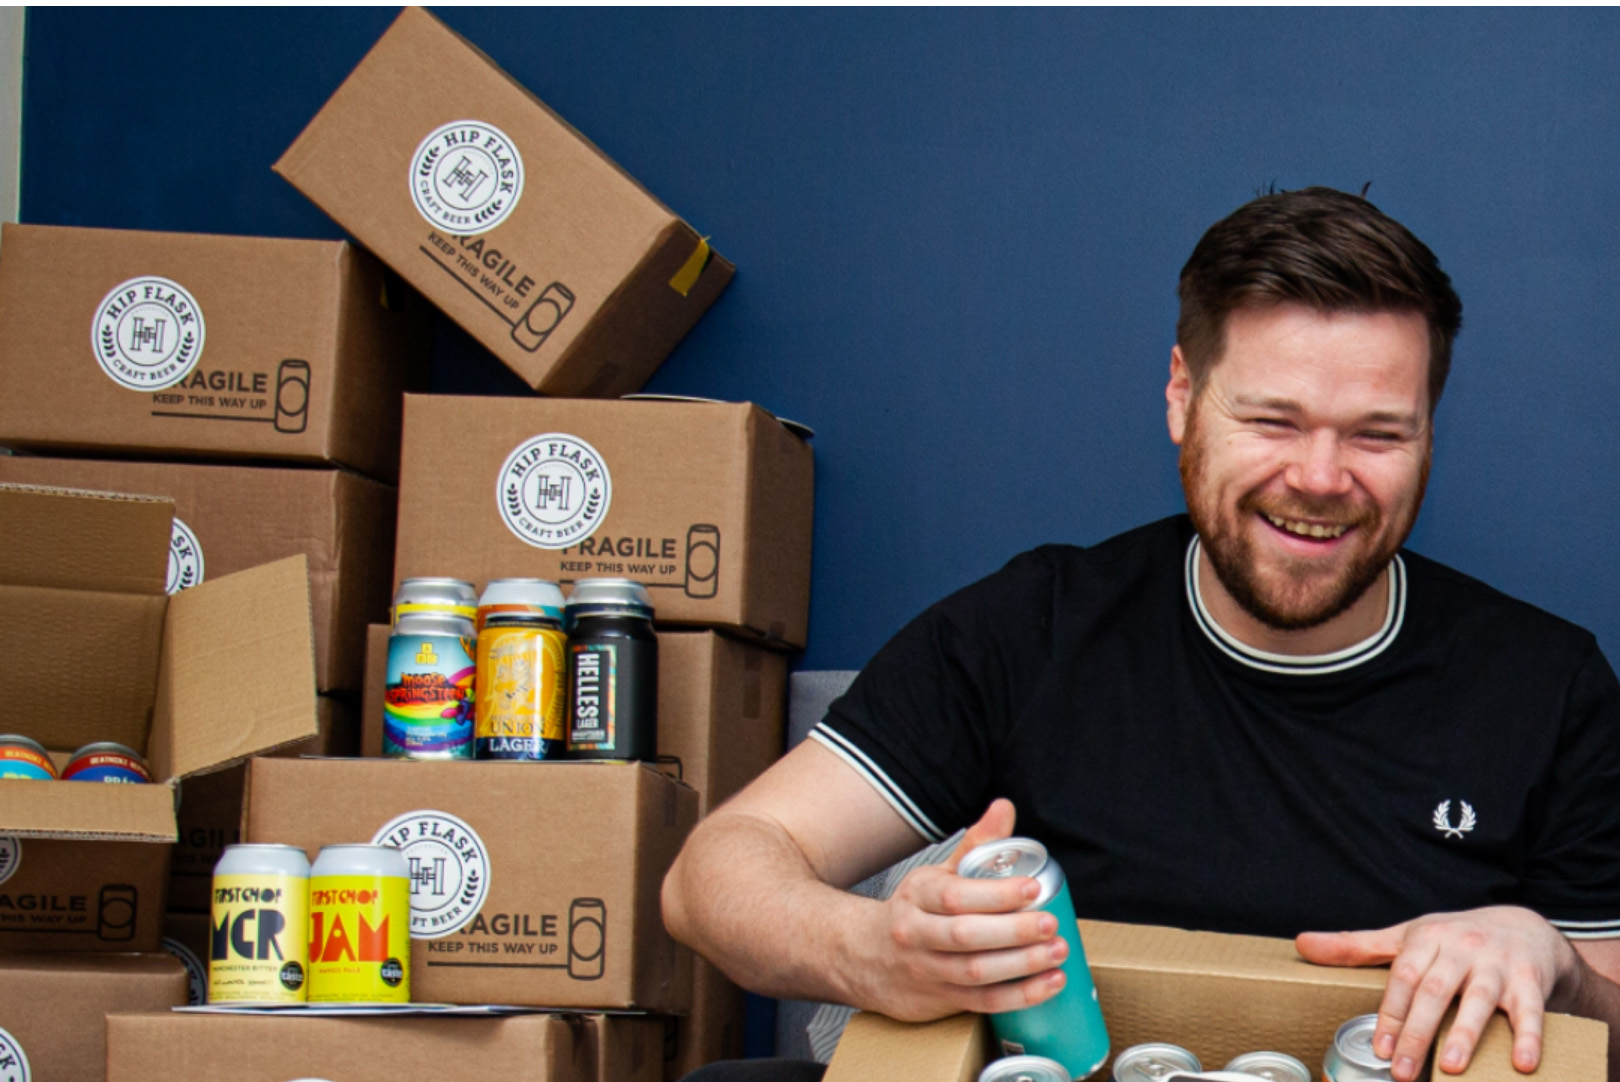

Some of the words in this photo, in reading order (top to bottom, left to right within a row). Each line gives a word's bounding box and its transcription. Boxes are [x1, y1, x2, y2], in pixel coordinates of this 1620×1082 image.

[443, 130, 480, 147] HIP
[483, 135, 514, 194] FLASK
[420, 179, 443, 216] CRAFT
[442, 210, 472, 225] BEER
[428, 232, 457, 256] KEEP
[456, 254, 480, 278] THIS
[479, 273, 505, 298] WAY
[503, 294, 520, 311] UP
[452, 234, 536, 298] AGILE
[106, 289, 137, 320] HIP
[144, 286, 194, 325] FLASK
[112, 358, 146, 381] CRAFT
[150, 362, 177, 381] BEER
[171, 370, 268, 393] AGILE
[152, 394, 185, 405] KEEP
[188, 395, 215, 407] THIS
[218, 397, 247, 409] WAY
[250, 398, 267, 410] UP
[511, 447, 541, 478] HIP
[548, 443, 600, 482] FLASK
[518, 516, 553, 539] CRAFT
[556, 521, 584, 538] BEER
[560, 560, 593, 572] KEEP
[596, 561, 623, 573] THIS
[627, 562, 656, 574] WAY
[659, 564, 676, 575] UP
[577, 653, 600, 717] HELLES
[491, 721, 545, 734] UNION
[576, 717, 600, 729] LAGER
[489, 739, 546, 753] LAGER
[384, 826, 410, 847] IP
[419, 821, 478, 862] FLASK
[0, 895, 87, 912] AGILE
[0, 914, 26, 923] HIS
[30, 915, 63, 924] WAY
[67, 915, 87, 924] UP
[432, 907, 462, 926] BEER
[457, 914, 558, 937] AGILE
[309, 911, 390, 963] JAM
[428, 941, 464, 953] KEEP
[469, 942, 499, 953] THIS
[504, 942, 535, 954] WAY
[539, 943, 558, 954] UP
